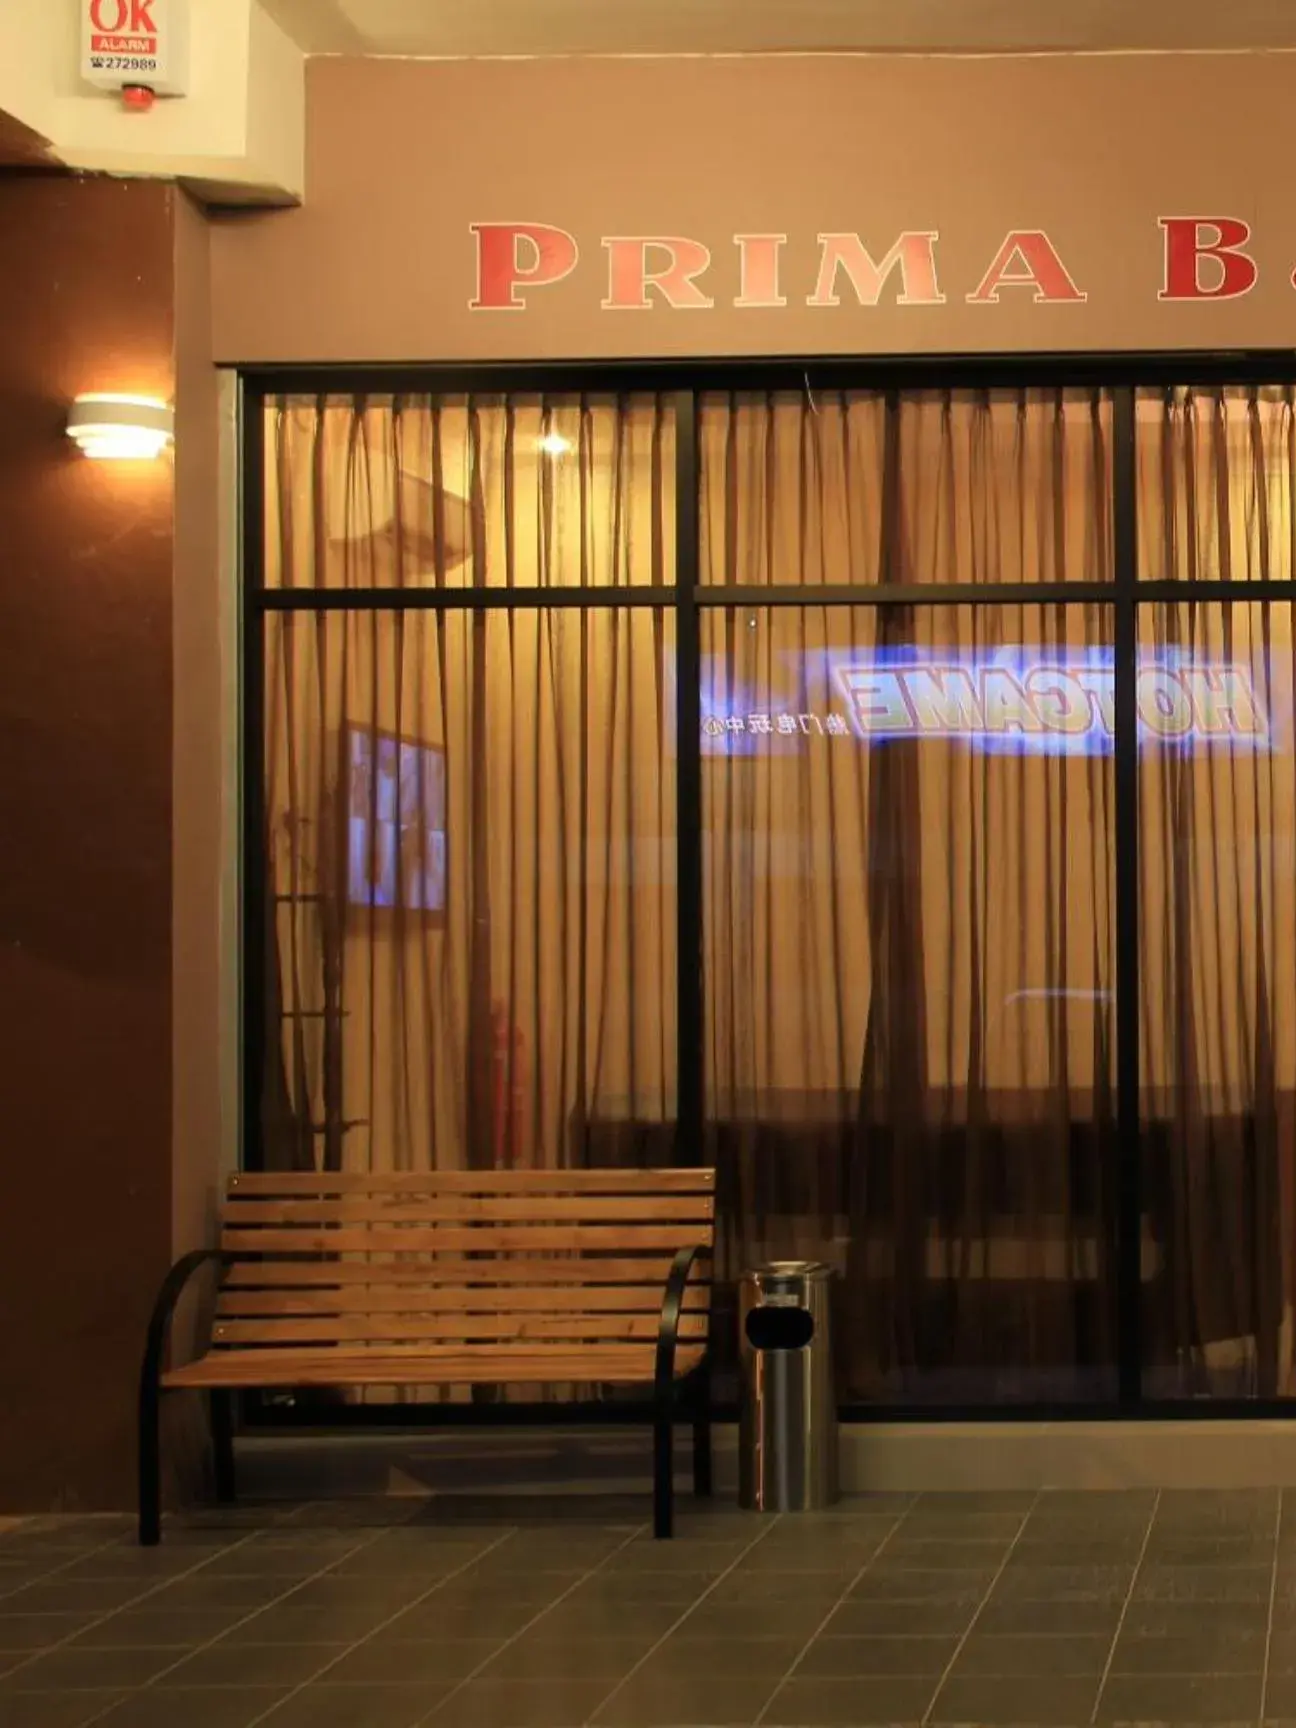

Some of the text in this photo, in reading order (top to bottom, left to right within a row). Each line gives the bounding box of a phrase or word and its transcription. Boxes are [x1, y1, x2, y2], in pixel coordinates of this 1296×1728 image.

[90, 0, 157, 33] OK
[99, 37, 151, 52] ALARM
[105, 57, 157, 71] 272989
[468, 222, 1088, 310] PRIMA
